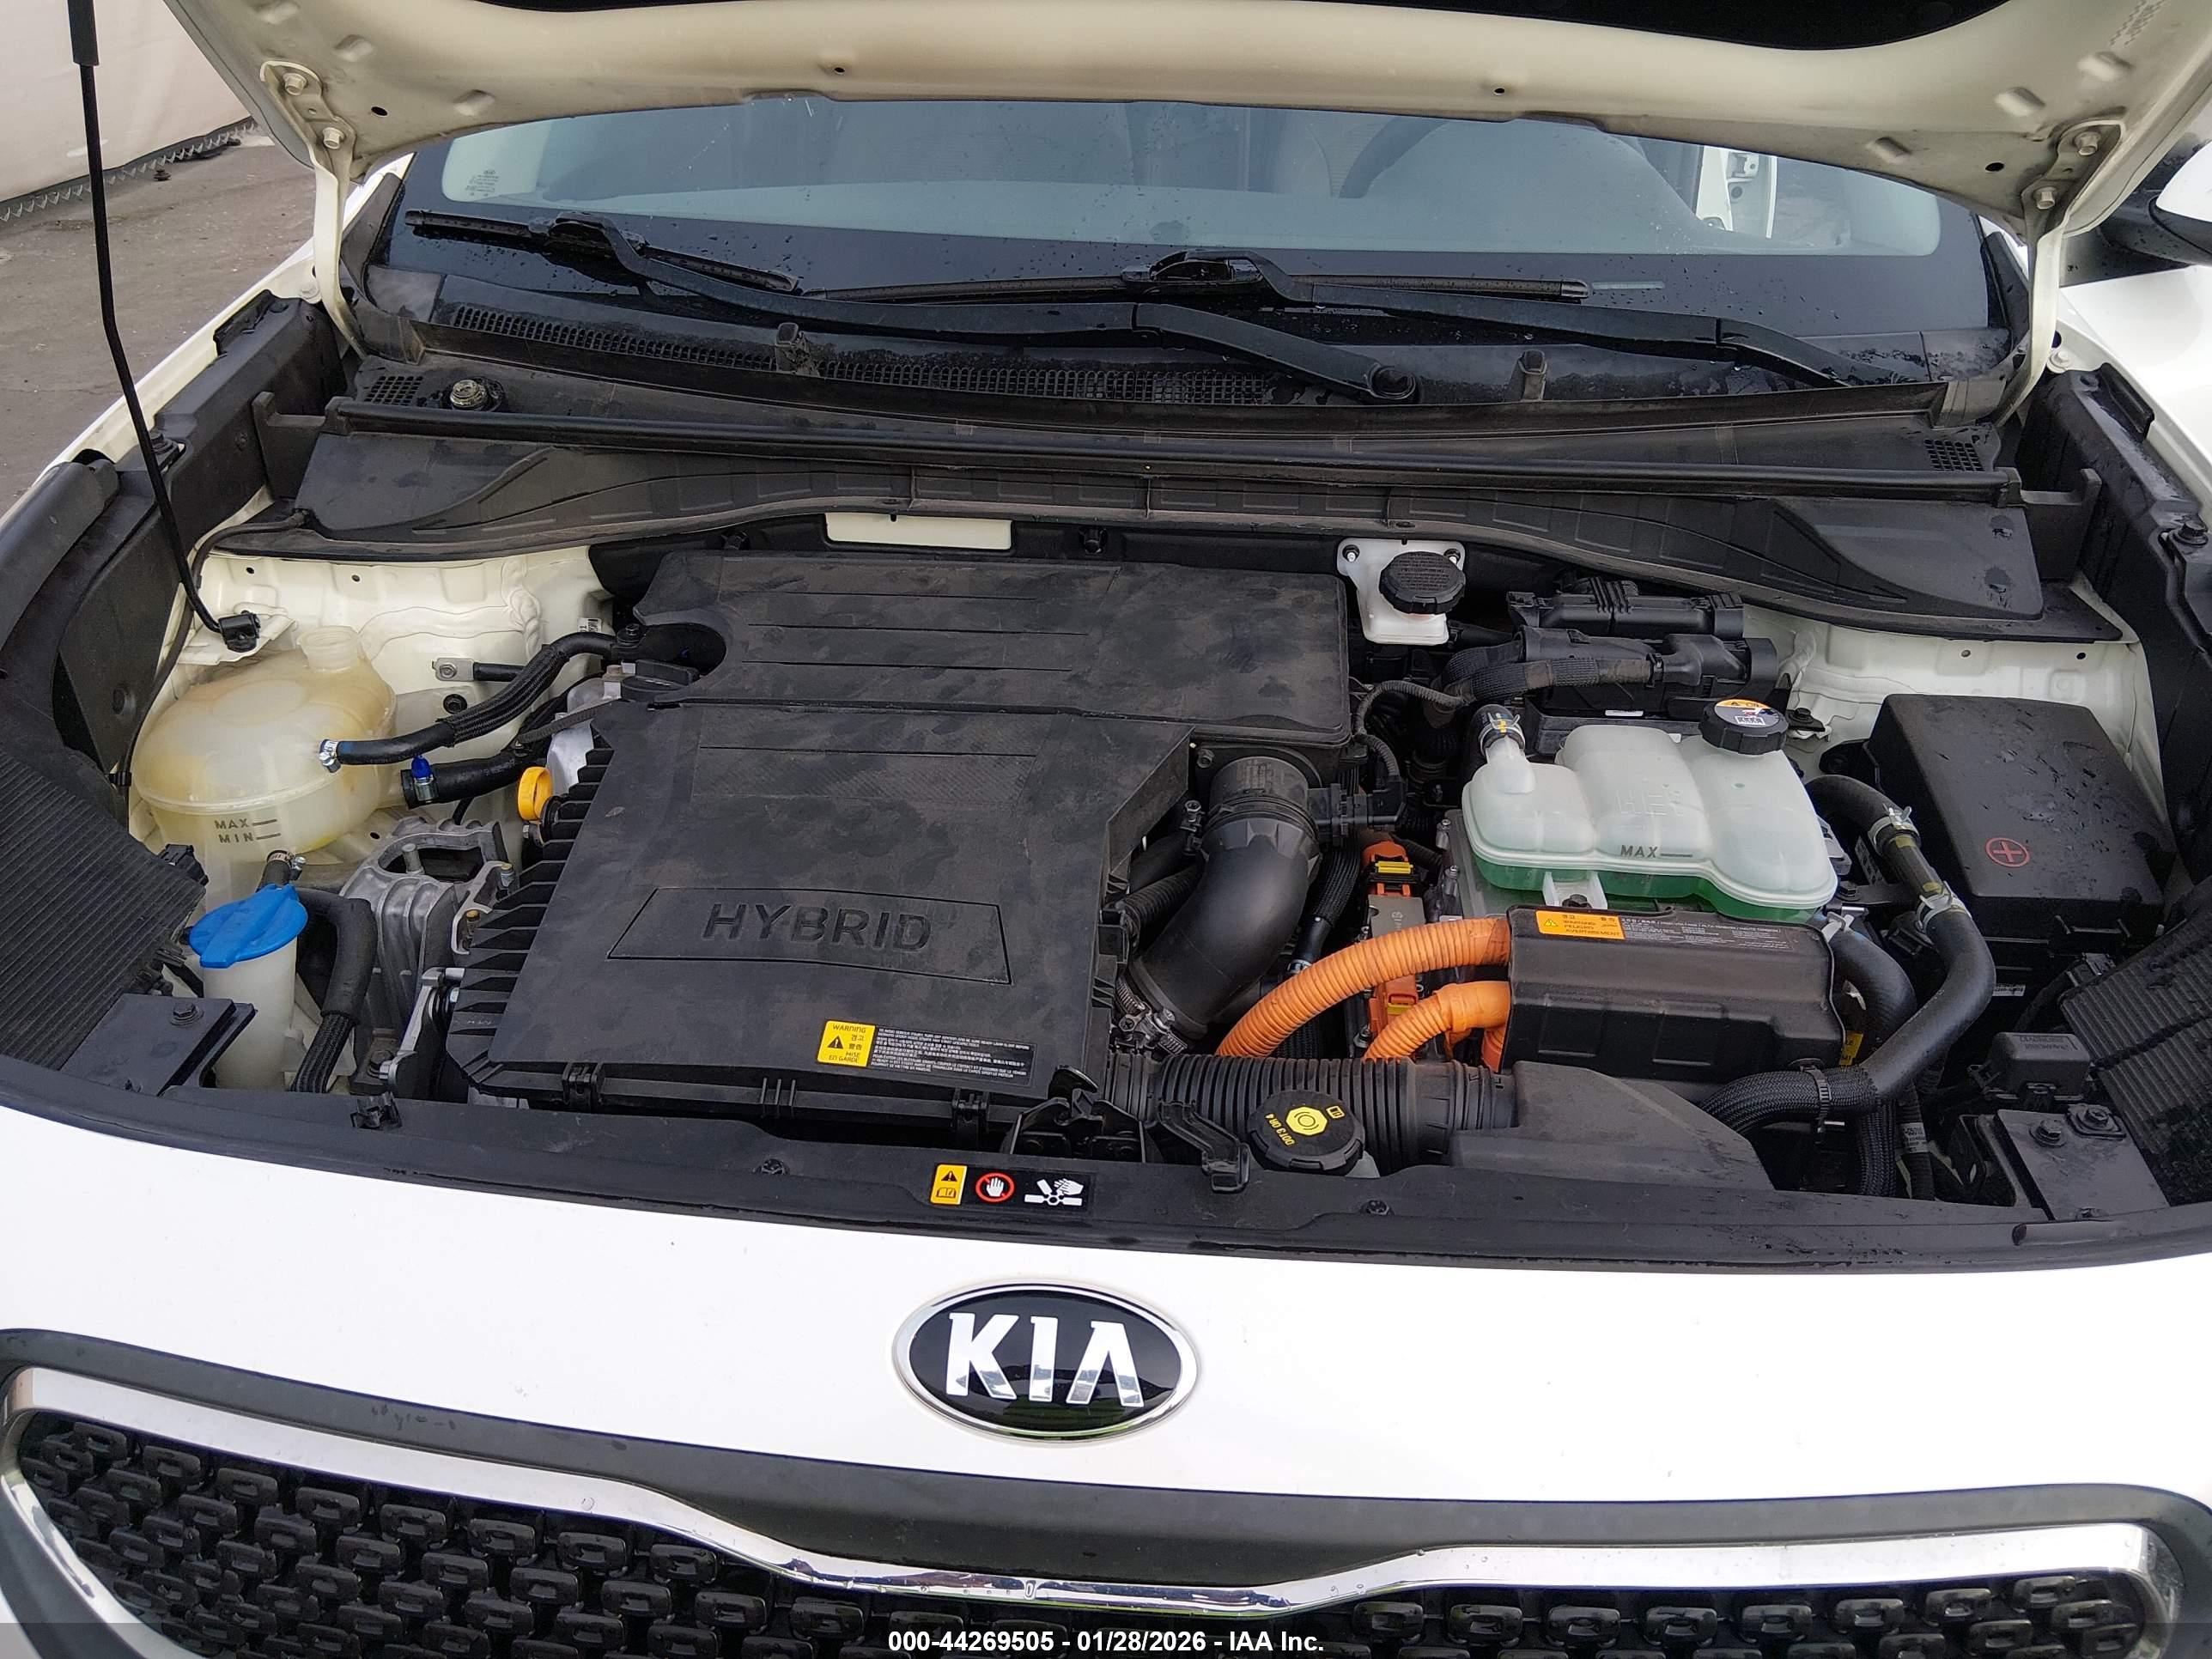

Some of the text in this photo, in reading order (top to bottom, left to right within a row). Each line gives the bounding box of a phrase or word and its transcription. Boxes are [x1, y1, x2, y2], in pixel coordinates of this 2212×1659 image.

[214, 817, 250, 830] MAX
[218, 832, 254, 843] MIN
[1620, 844, 1658, 858] MAX
[702, 903, 933, 952] HYBRID
[832, 1024, 866, 1033] WARNING
[945, 1312, 1145, 1407] KIA
